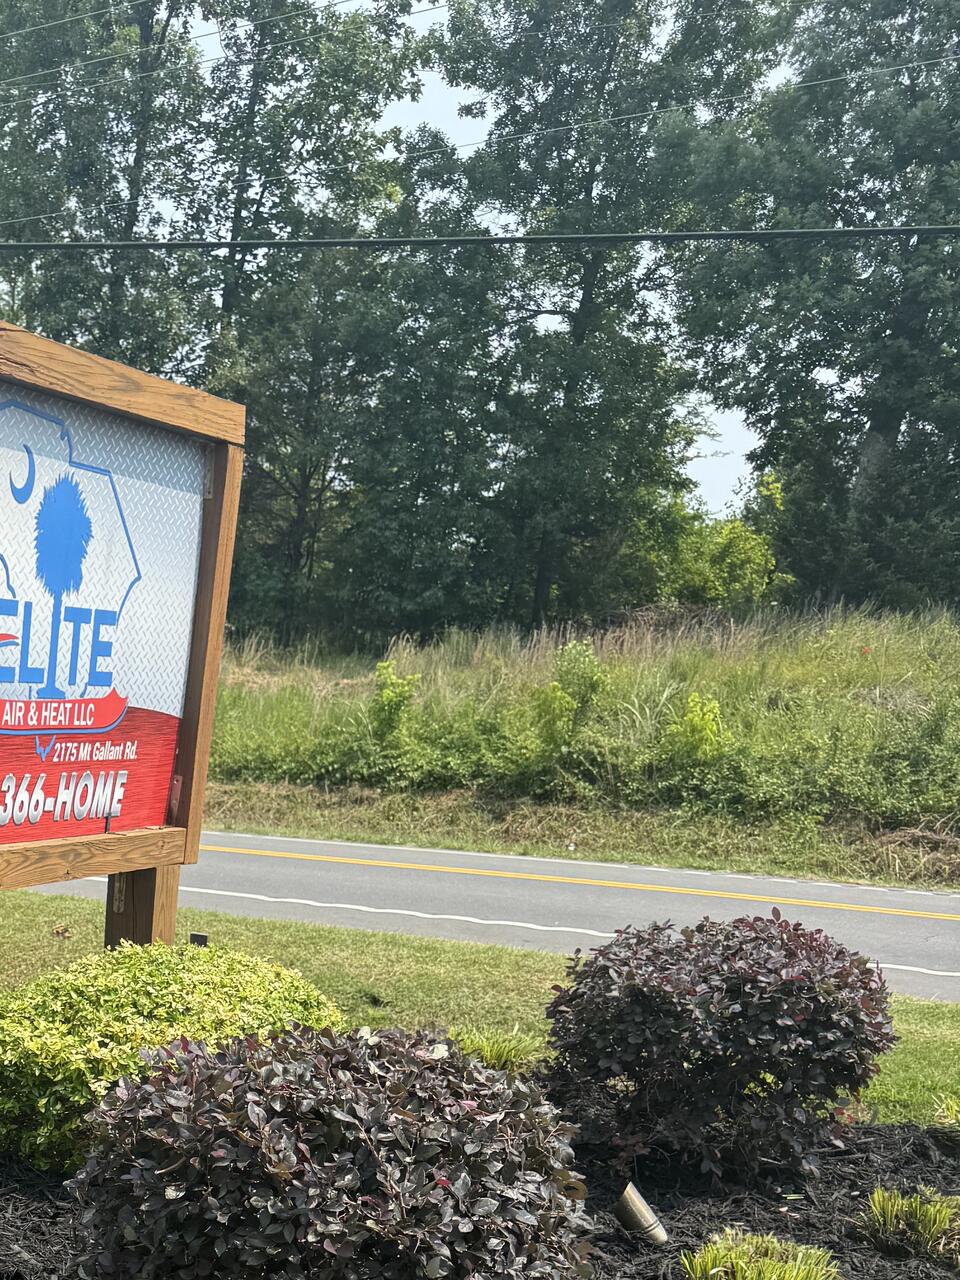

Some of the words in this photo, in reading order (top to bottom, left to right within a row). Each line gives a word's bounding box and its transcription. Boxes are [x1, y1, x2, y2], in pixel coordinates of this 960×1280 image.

[2, 701, 25, 726] AIR
[28, 702, 38, 725] &
[41, 701, 72, 726] HEAT
[73, 704, 95, 726] LLC
[53, 743, 77, 762] 2175
[78, 744, 92, 761] Mt
[93, 741, 123, 761] Gallant
[124, 741, 138, 760] Rd.
